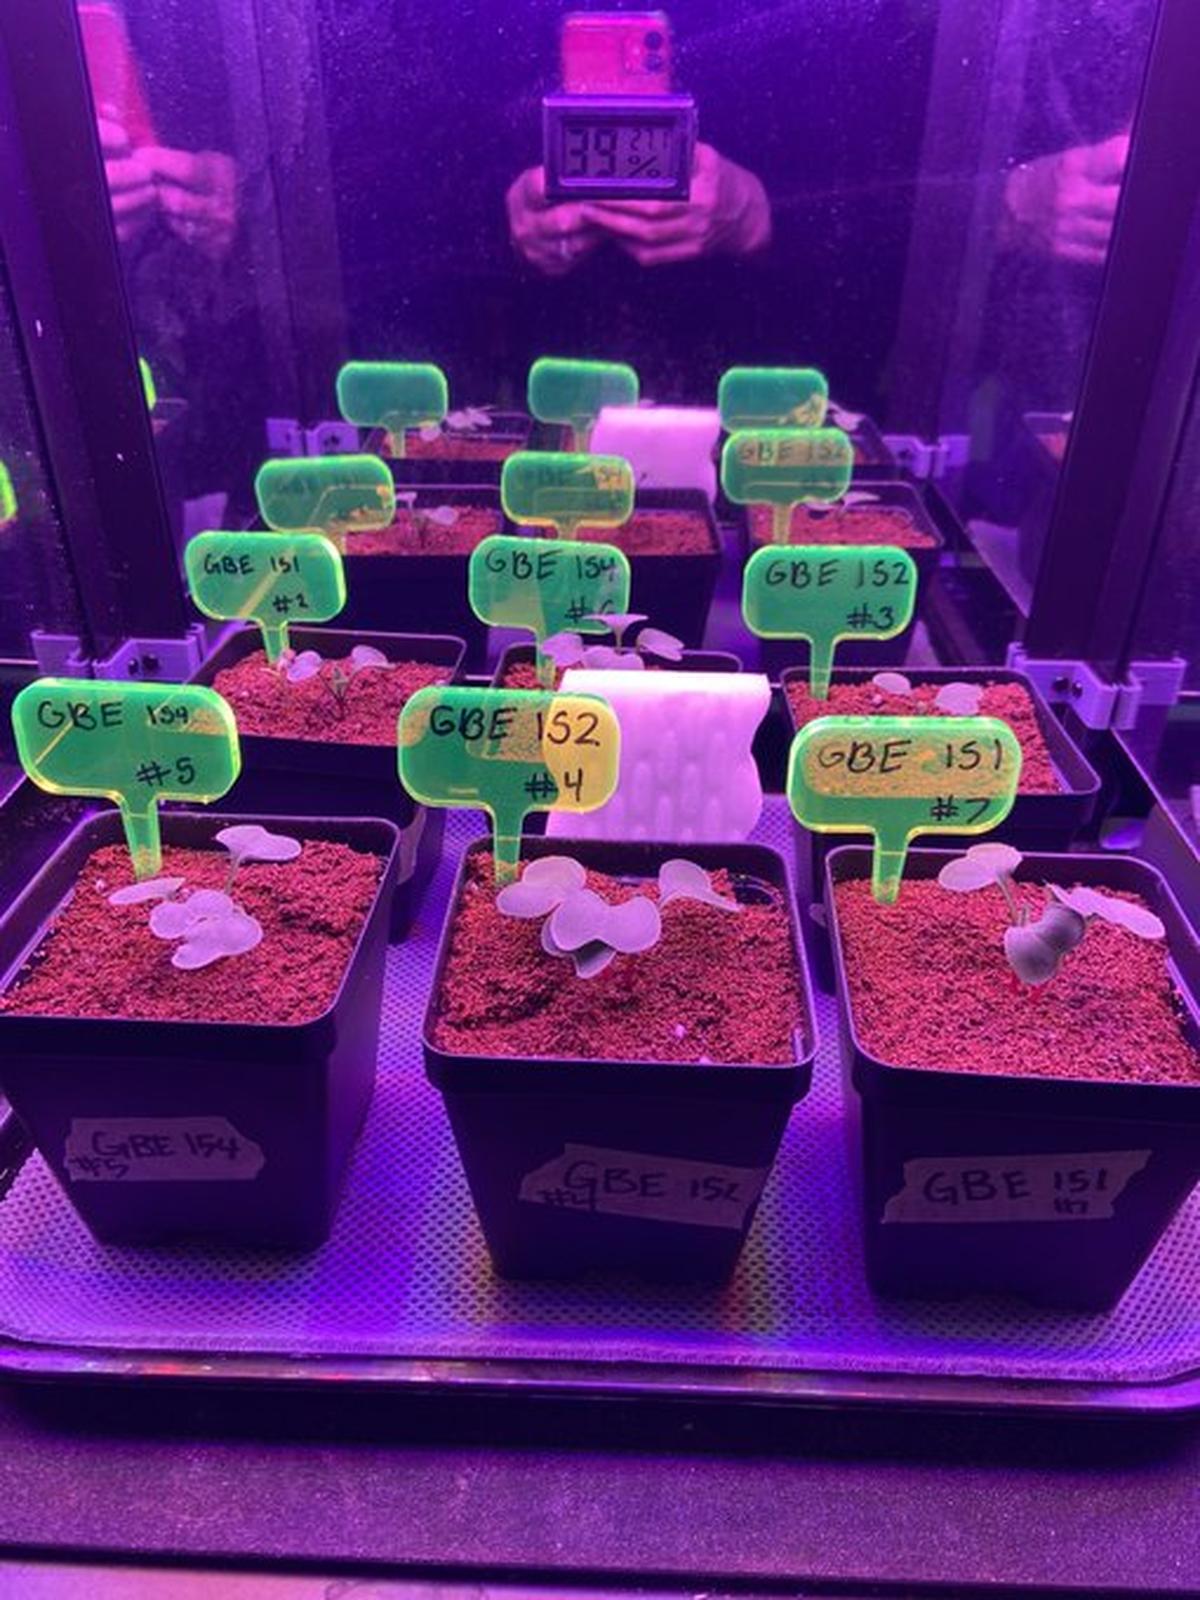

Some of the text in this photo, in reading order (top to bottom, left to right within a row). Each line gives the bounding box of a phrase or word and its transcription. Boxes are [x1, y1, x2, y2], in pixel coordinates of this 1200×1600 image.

[568, 127, 618, 176] 39
[204, 553, 301, 575] GBE 151
[485, 548, 615, 582] GBE 154
[765, 559, 909, 589] GBE 152
[272, 593, 309, 614] #2
[846, 602, 895, 630] #3
[37, 700, 189, 732] GBE 154
[430, 704, 601, 747] GBE 152
[135, 756, 196, 787] #5
[817, 738, 1004, 774] GBE 151
[524, 767, 584, 803] #4
[930, 794, 992, 824] #7
[91, 1130, 239, 1161] GBE 154
[563, 1160, 668, 1199] GBE
[922, 1167, 1108, 1206] GBE 151
